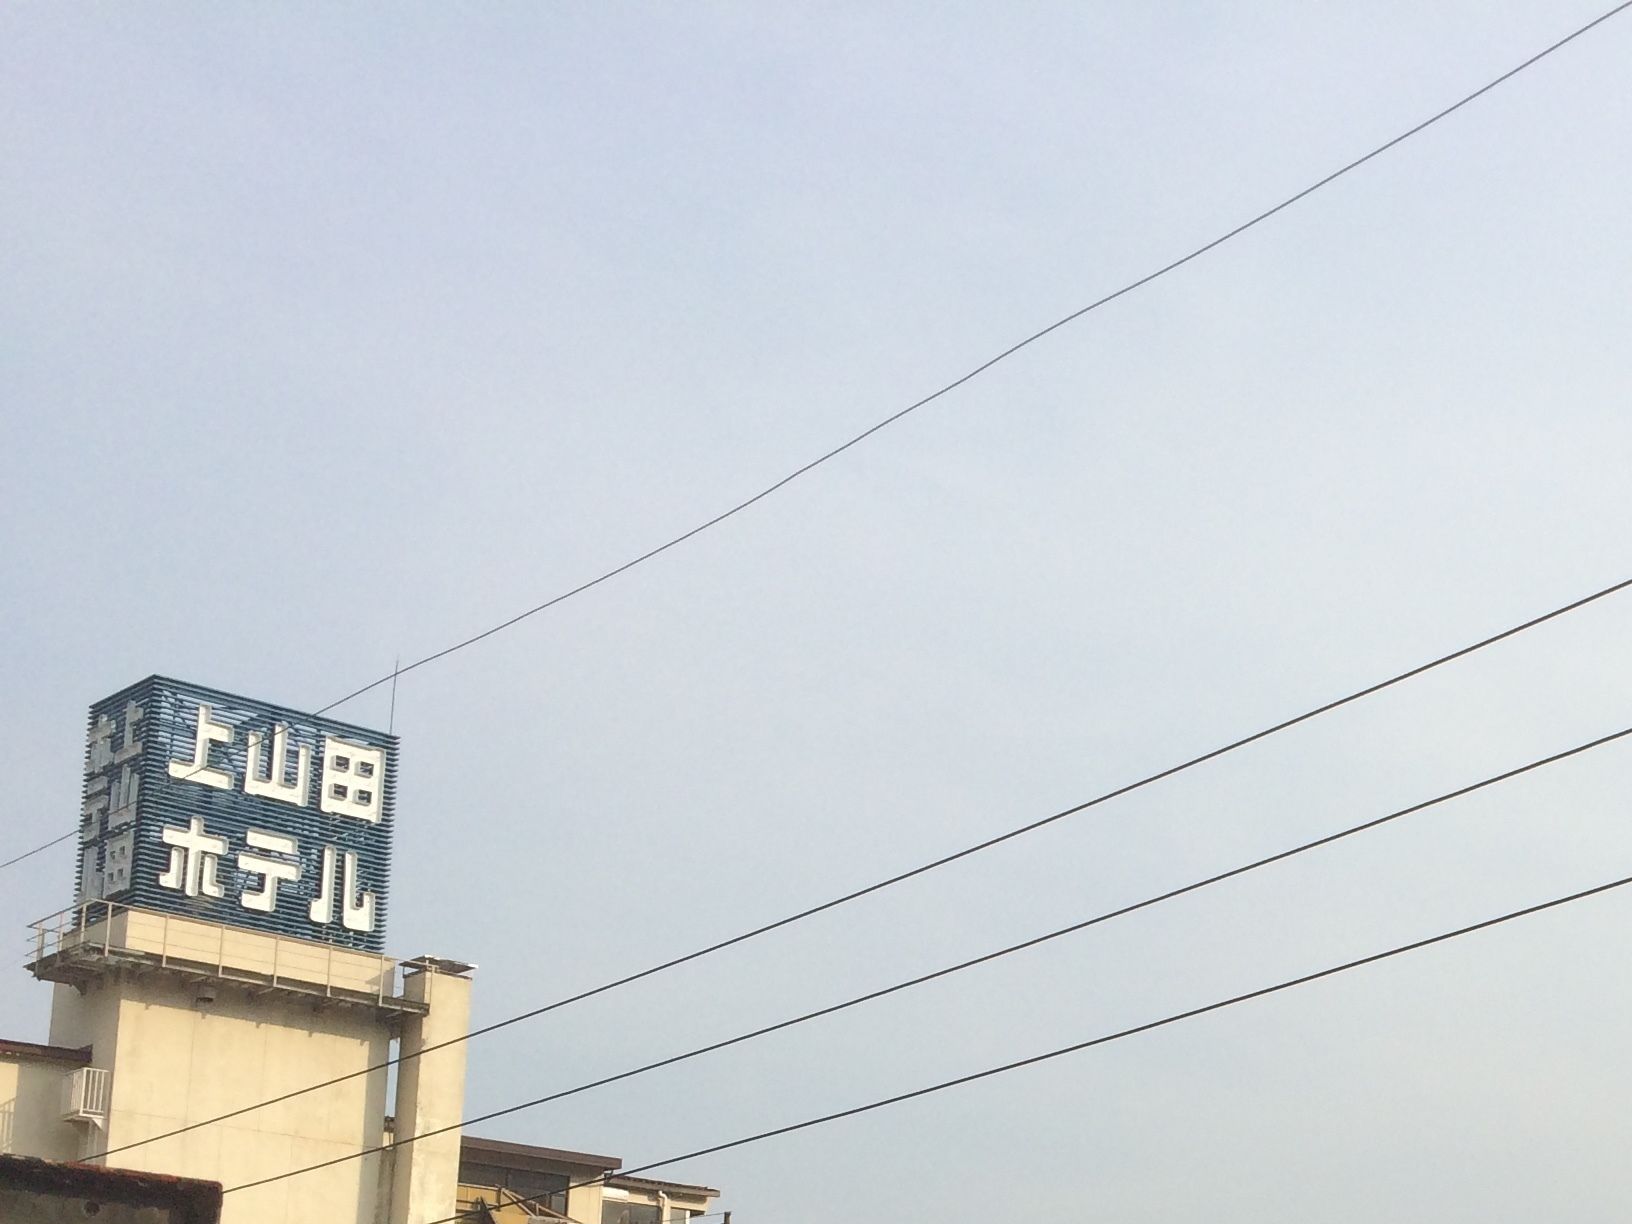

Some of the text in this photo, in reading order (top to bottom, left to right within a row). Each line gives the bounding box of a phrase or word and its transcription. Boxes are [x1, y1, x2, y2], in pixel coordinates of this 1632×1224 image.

[168, 703, 387, 823] 上山田
[159, 816, 376, 931] ホテル
